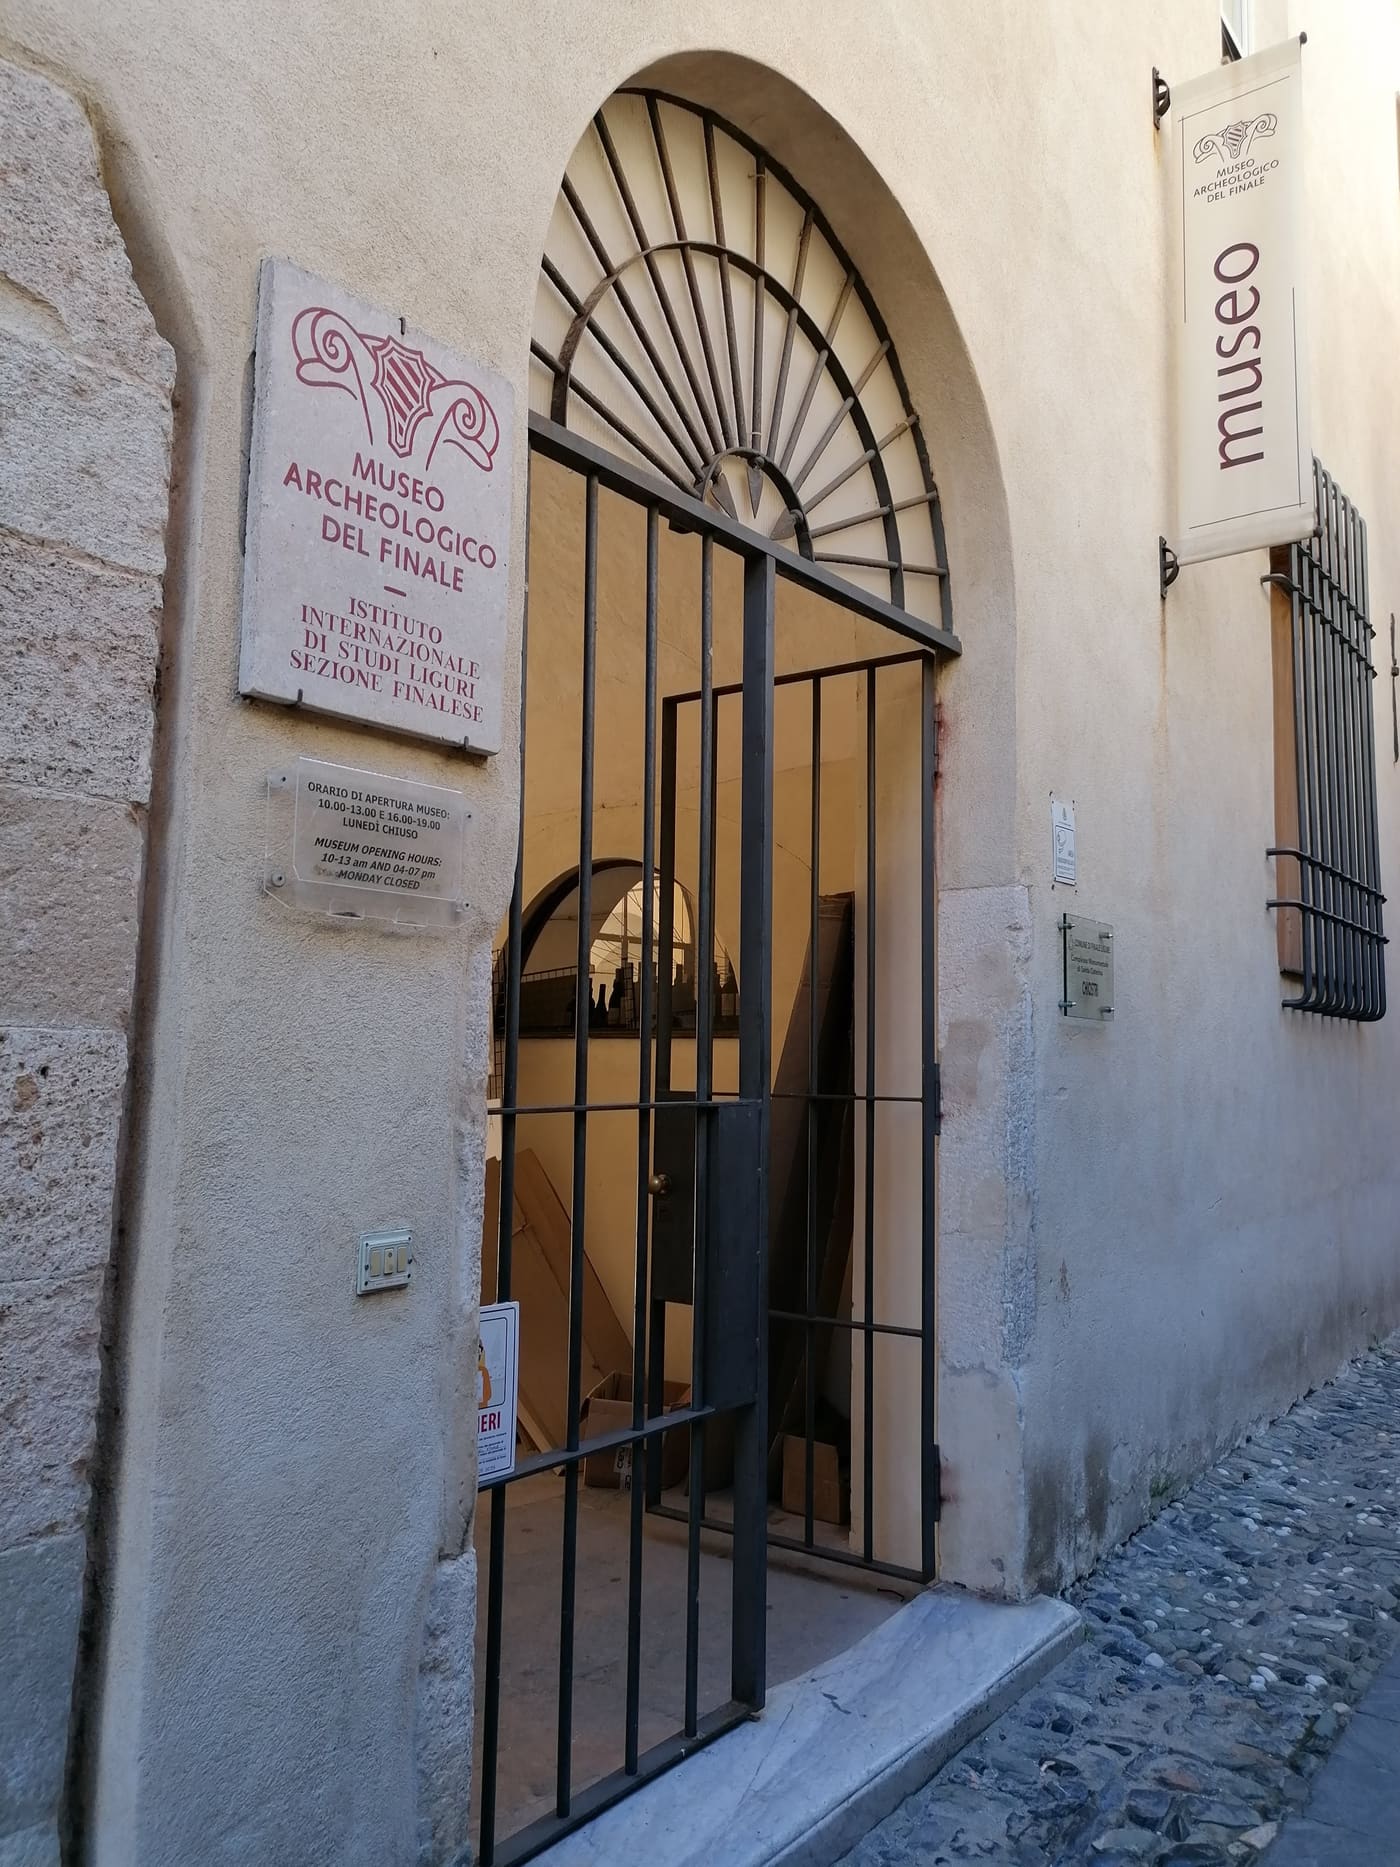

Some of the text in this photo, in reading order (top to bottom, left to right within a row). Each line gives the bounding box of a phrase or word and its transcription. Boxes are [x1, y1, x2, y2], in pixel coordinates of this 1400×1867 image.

[1193, 159, 1280, 198] ARCHEOLOGICO
[1216, 158, 1255, 178] MUSEO
[1207, 175, 1265, 203] DEL FINALE
[1213, 242, 1265, 470] museo
[352, 452, 444, 512] MUSEO
[283, 462, 497, 569] ARCHEOLOGICO
[321, 514, 464, 593] DEL FINALE
[349, 596, 443, 644] ISTITUTO
[301, 604, 481, 680] INTERNAZIONALE
[304, 628, 476, 700] DI STUDI LIGURI
[289, 649, 484, 723] SEZIONE FINALESE
[308, 781, 450, 820] ORARIO DI APERTURA MUSEO:
[318, 798, 441, 831] 10.00-13.00 E 16.00-19.00
[382, 824, 418, 840] CHIUSO
[314, 837, 443, 867] MUSEUM OPENING HOURS:
[320, 852, 436, 880] 10-13 am AND 04-07 pm
[337, 869, 420, 890] MONDAY CLOSED
